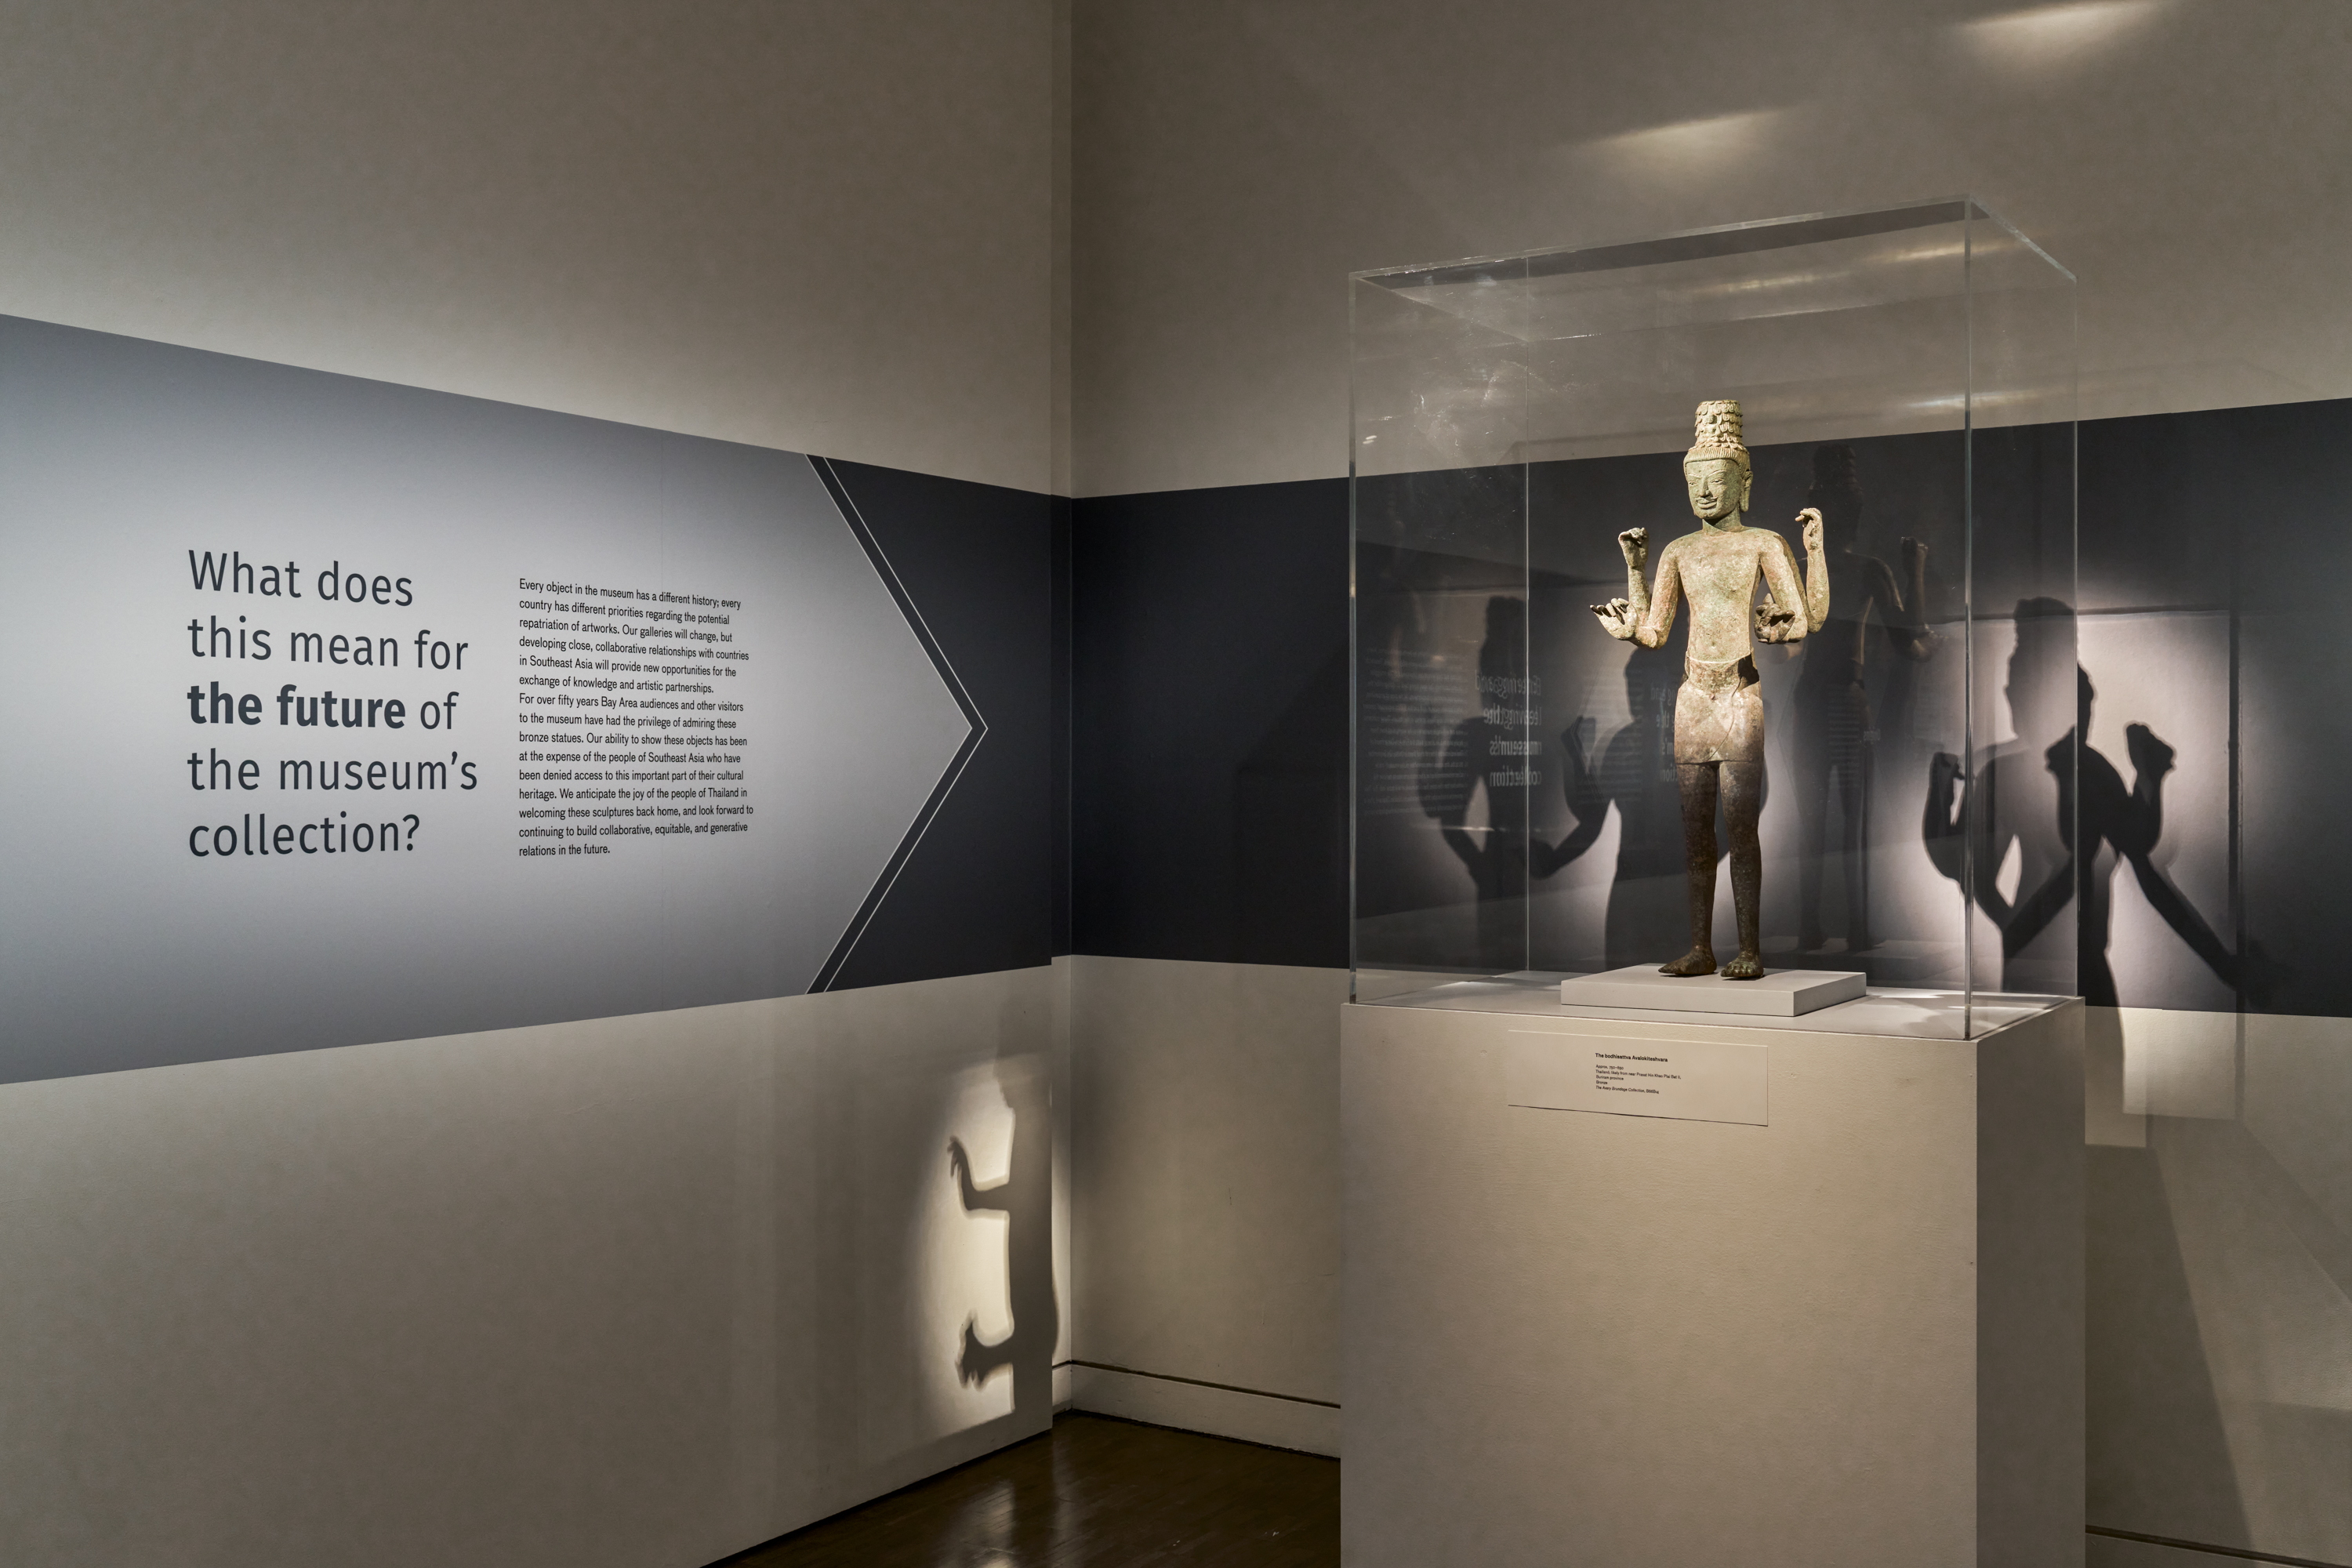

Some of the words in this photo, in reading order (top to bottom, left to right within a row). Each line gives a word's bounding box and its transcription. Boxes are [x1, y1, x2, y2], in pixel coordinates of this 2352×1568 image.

[189, 550, 301, 598] What
[318, 561, 412, 606] does
[520, 578, 544, 593] Every
[546, 581, 573, 595] object
[575, 583, 582, 594] in
[585, 584, 598, 596] the
[600, 589, 634, 599] museum
[636, 589, 650, 600] has
[659, 592, 690, 604] different
[692, 594, 719, 609] history;
[721, 600, 741, 611] every
[519, 600, 552, 613] country
[555, 600, 569, 612] has
[571, 602, 606, 615] different
[608, 605, 643, 618] priorities
[646, 610, 682, 624] regarding
[684, 611, 696, 622] the
[698, 614, 729, 624] potential
[520, 618, 568, 630] repatriation
[571, 621, 580, 631] of
[582, 623, 620, 634] artworks.
[622, 624, 638, 635] Our
[640, 626, 673, 639] galleries
[674, 629, 687, 639] will
[690, 629, 718, 643] change,
[721, 632, 732, 642] but
[188, 615, 271, 660] this
[291, 632, 397, 666] mean
[415, 630, 468, 670] for
[519, 636, 567, 652] developing
[569, 639, 593, 652] close,
[595, 641, 646, 654] collaborative
[649, 645, 696, 659] relationships
[698, 648, 714, 658] with
[716, 650, 749, 660] countries
[519, 674, 560, 689] exchange
[563, 676, 571, 686] of
[573, 676, 617, 691] knowledge
[620, 679, 634, 690] and
[637, 680, 663, 691] artistic
[666, 682, 714, 695] partnerships.
[187, 681, 262, 725] the
[277, 684, 405, 729] future
[420, 691, 459, 729] of
[519, 693, 534, 704] For
[537, 697, 556, 705] over
[558, 694, 574, 708] fifty
[576, 698, 599, 708] years
[601, 696, 617, 710] Bay
[619, 697, 638, 708] Area
[640, 698, 679, 709] audiences
[681, 700, 694, 710] and
[697, 700, 716, 711] other
[718, 701, 744, 711] visitors
[519, 713, 528, 723] to
[530, 712, 544, 723] the
[547, 716, 582, 724] museum
[585, 714, 604, 725] have
[606, 715, 621, 725] had
[623, 715, 635, 726] the
[638, 716, 671, 730] privilege
[673, 717, 681, 727] of
[682, 717, 715, 731] admiring
[717, 718, 736, 728] these
[519, 731, 549, 742] bronze
[552, 733, 584, 743] statues.
[586, 732, 603, 743] Our
[605, 733, 629, 746] ability
[631, 734, 639, 744] to
[641, 734, 662, 744] show
[664, 734, 684, 745] these
[686, 735, 713, 748] objects
[715, 735, 728, 745] has
[730, 736, 747, 746] been
[519, 751, 527, 761] at
[530, 750, 544, 761] the
[546, 754, 581, 764] expense
[583, 751, 592, 762] of
[594, 751, 606, 762] the
[609, 751, 636, 764] people
[638, 752, 646, 762] of
[648, 752, 686, 762] Southeast
[688, 752, 705, 762] Asia
[706, 753, 722, 763] who
[724, 753, 740, 763] have
[187, 748, 260, 790] the
[280, 751, 477, 790] museum’s
[519, 769, 540, 780] been
[543, 769, 572, 780] denied
[605, 770, 613, 780] to
[615, 770, 630, 780] this
[632, 770, 669, 783] important
[672, 771, 687, 783] part
[689, 770, 697, 780] of
[698, 770, 715, 780] their
[717, 770, 743, 780] cultural
[519, 788, 557, 802] heritage.
[559, 788, 573, 799] We
[576, 788, 616, 801] anticipate
[618, 788, 631, 798] the
[632, 788, 645, 801] joy
[647, 788, 655, 798] of
[657, 788, 669, 798] the
[671, 788, 696, 800] people
[698, 788, 706, 798] of
[708, 787, 739, 797] Thailand
[741, 787, 747, 797] in
[190, 811, 419, 857] collection?
[519, 826, 564, 839] continuing
[566, 826, 574, 836] to
[577, 825, 597, 836] build
[599, 824, 653, 835] collaborative,
[655, 823, 692, 836] equitable,
[695, 822, 708, 833] and
[710, 822, 748, 835] generative
[519, 845, 556, 856] relations
[559, 844, 566, 855] in
[569, 844, 581, 855] the
[584, 843, 610, 854] future.
